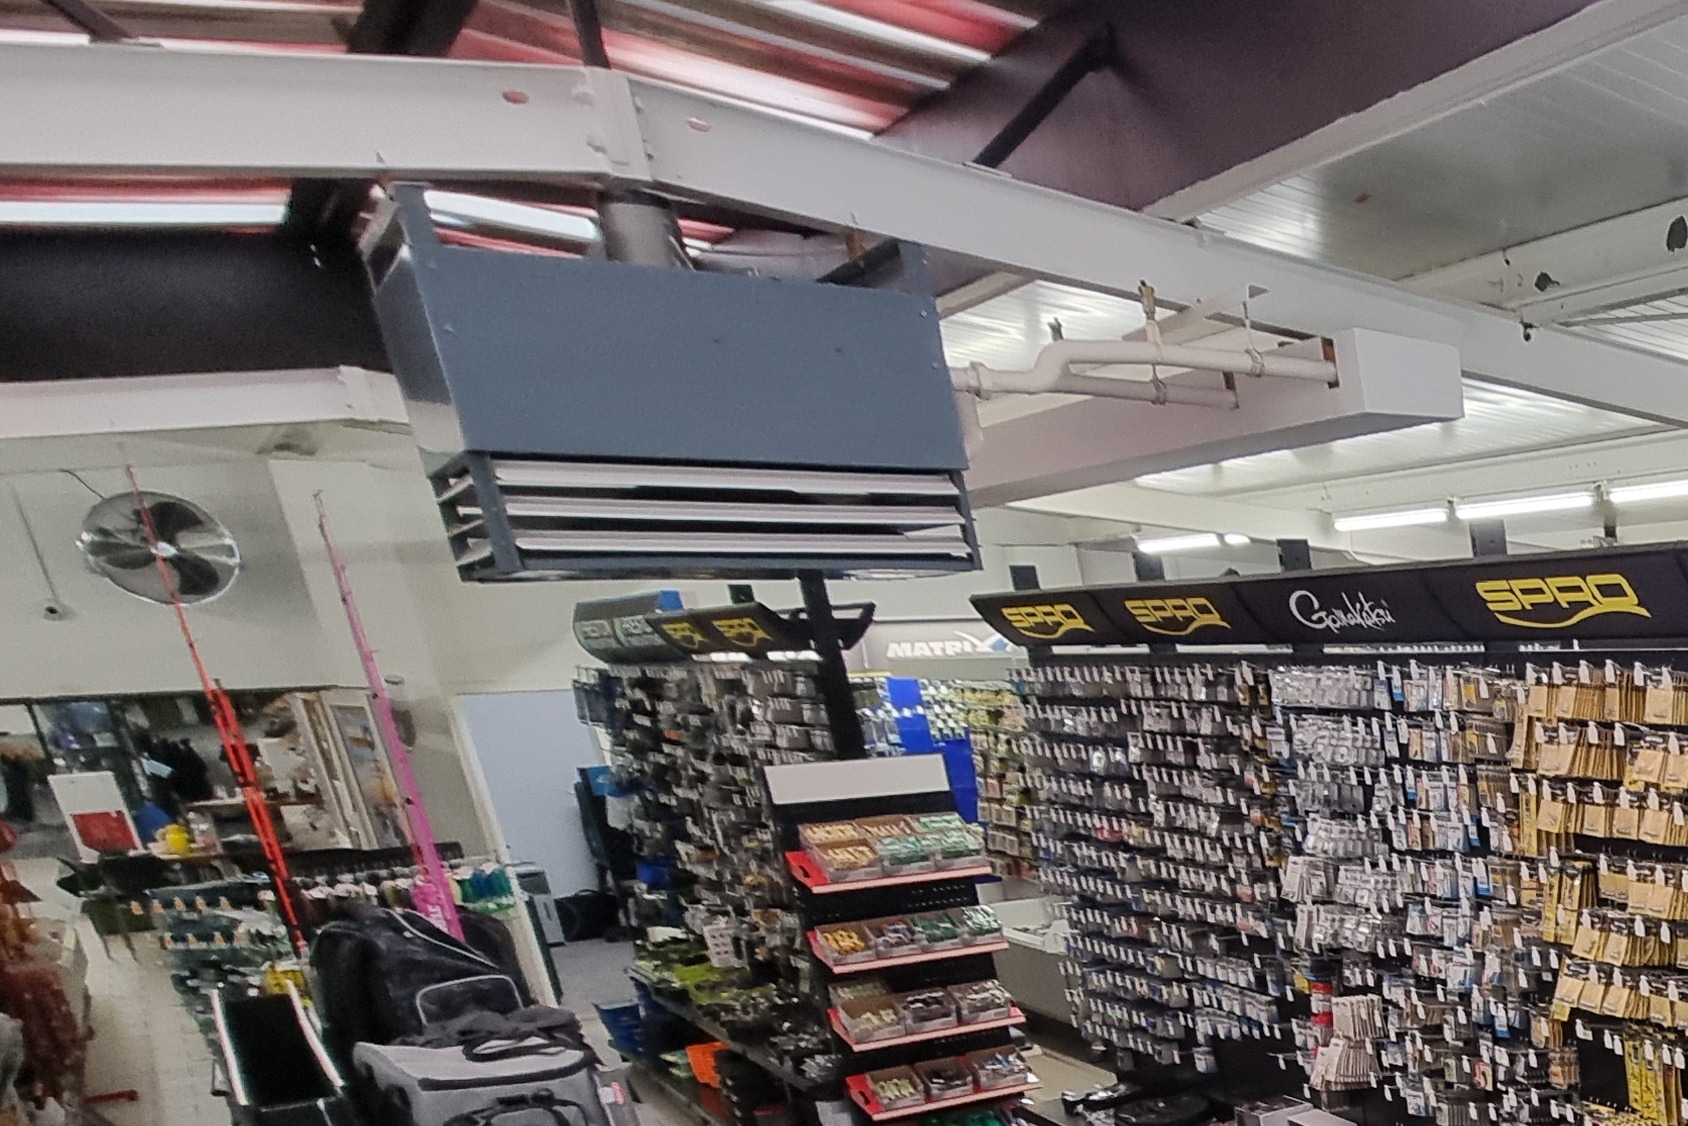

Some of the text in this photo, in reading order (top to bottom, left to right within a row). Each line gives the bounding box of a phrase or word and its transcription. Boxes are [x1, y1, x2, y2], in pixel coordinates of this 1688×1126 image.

[1476, 573, 1648, 619] SPRO
[1002, 604, 1092, 633] SPRO
[1125, 597, 1230, 630] SPRO
